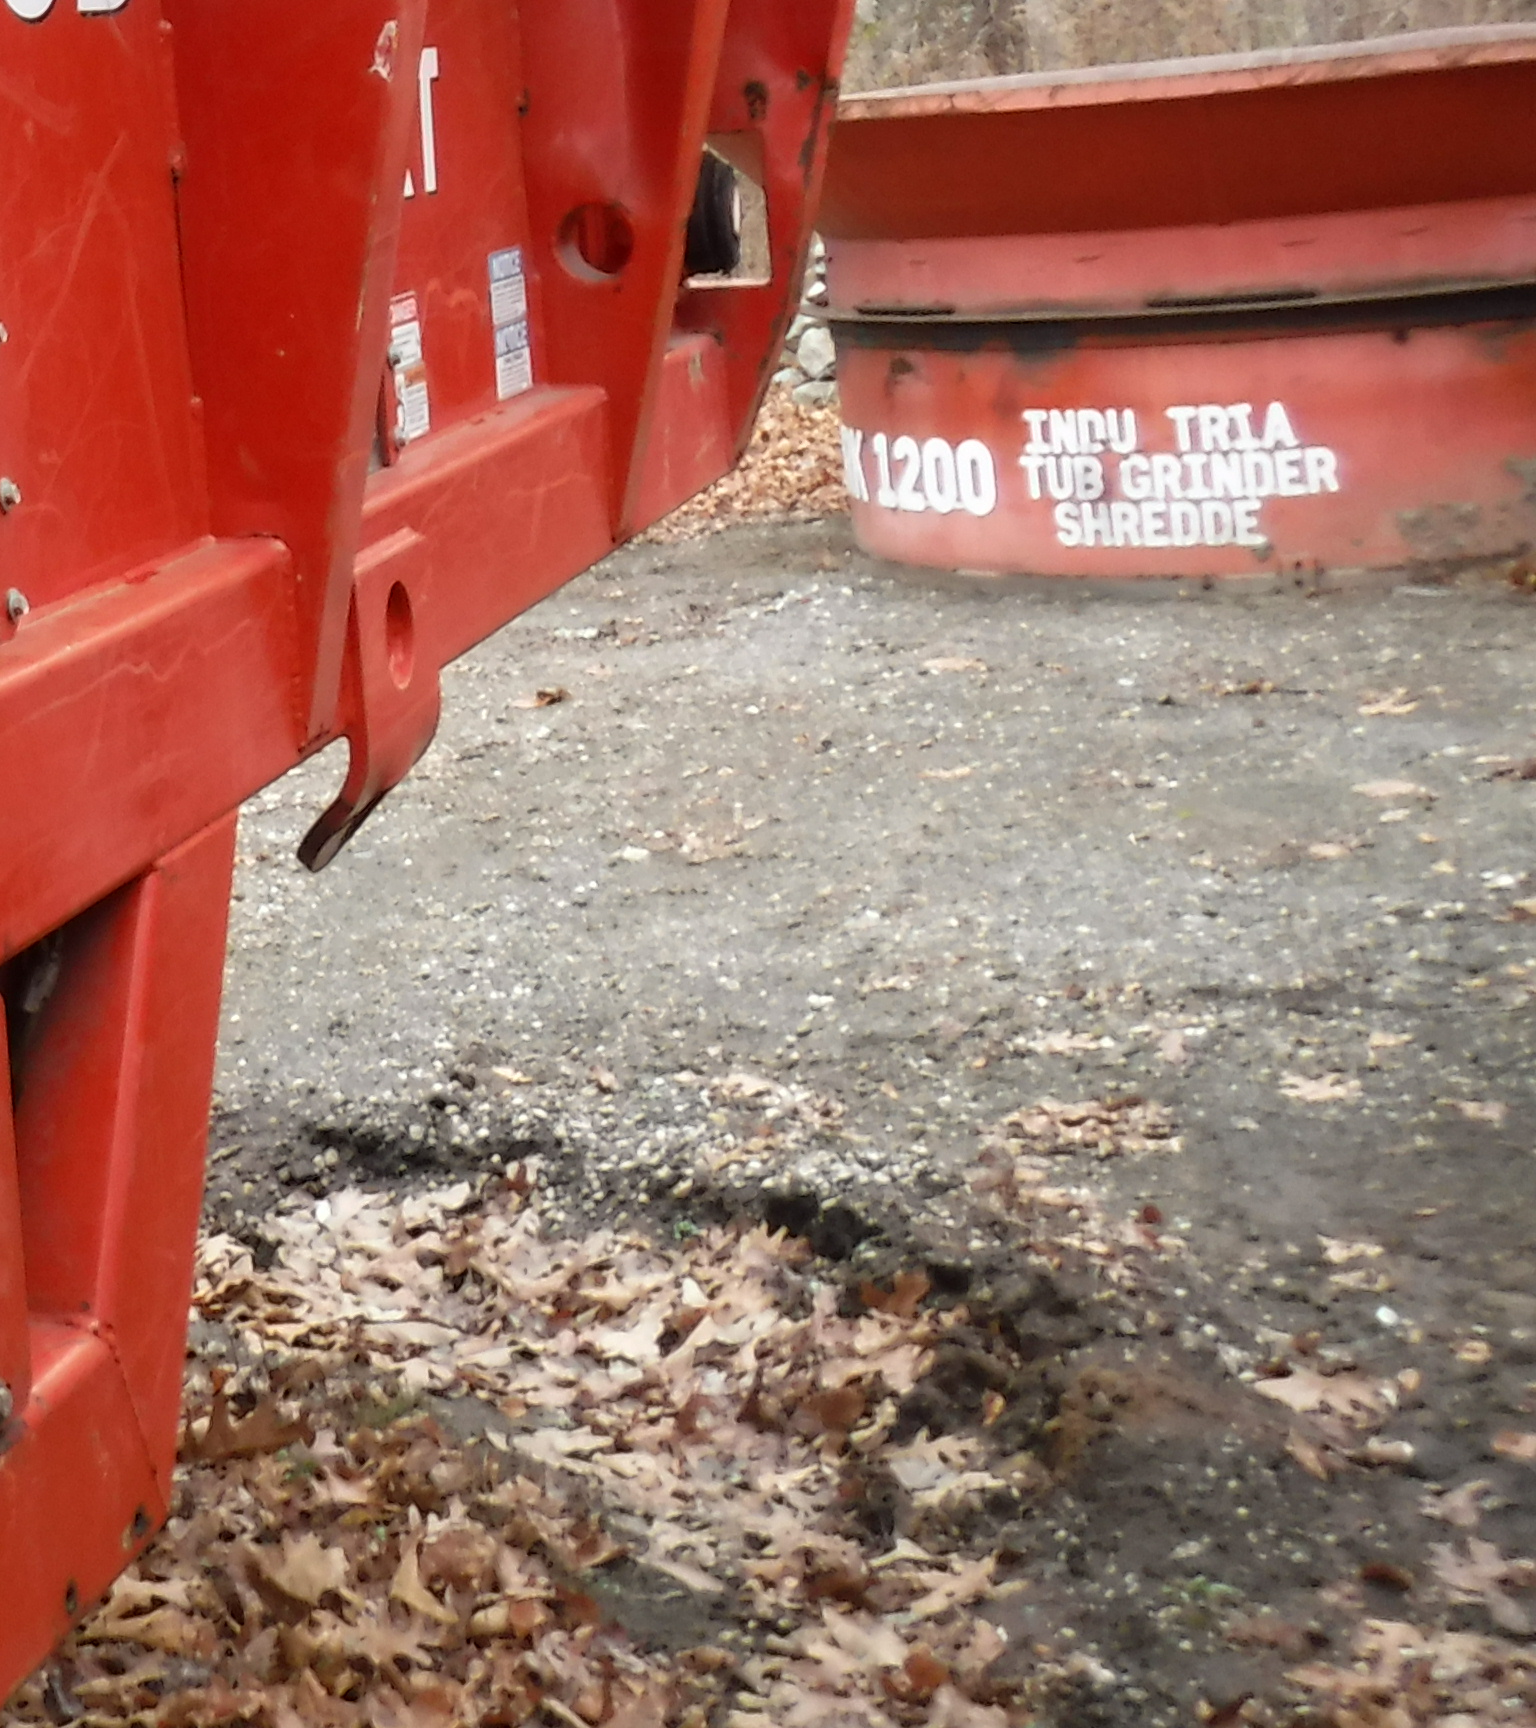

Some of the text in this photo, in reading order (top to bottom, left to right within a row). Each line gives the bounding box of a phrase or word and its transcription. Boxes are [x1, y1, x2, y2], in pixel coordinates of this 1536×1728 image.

[873, 432, 997, 516] 1200
[1019, 446, 1339, 500] TUB GRINDER
